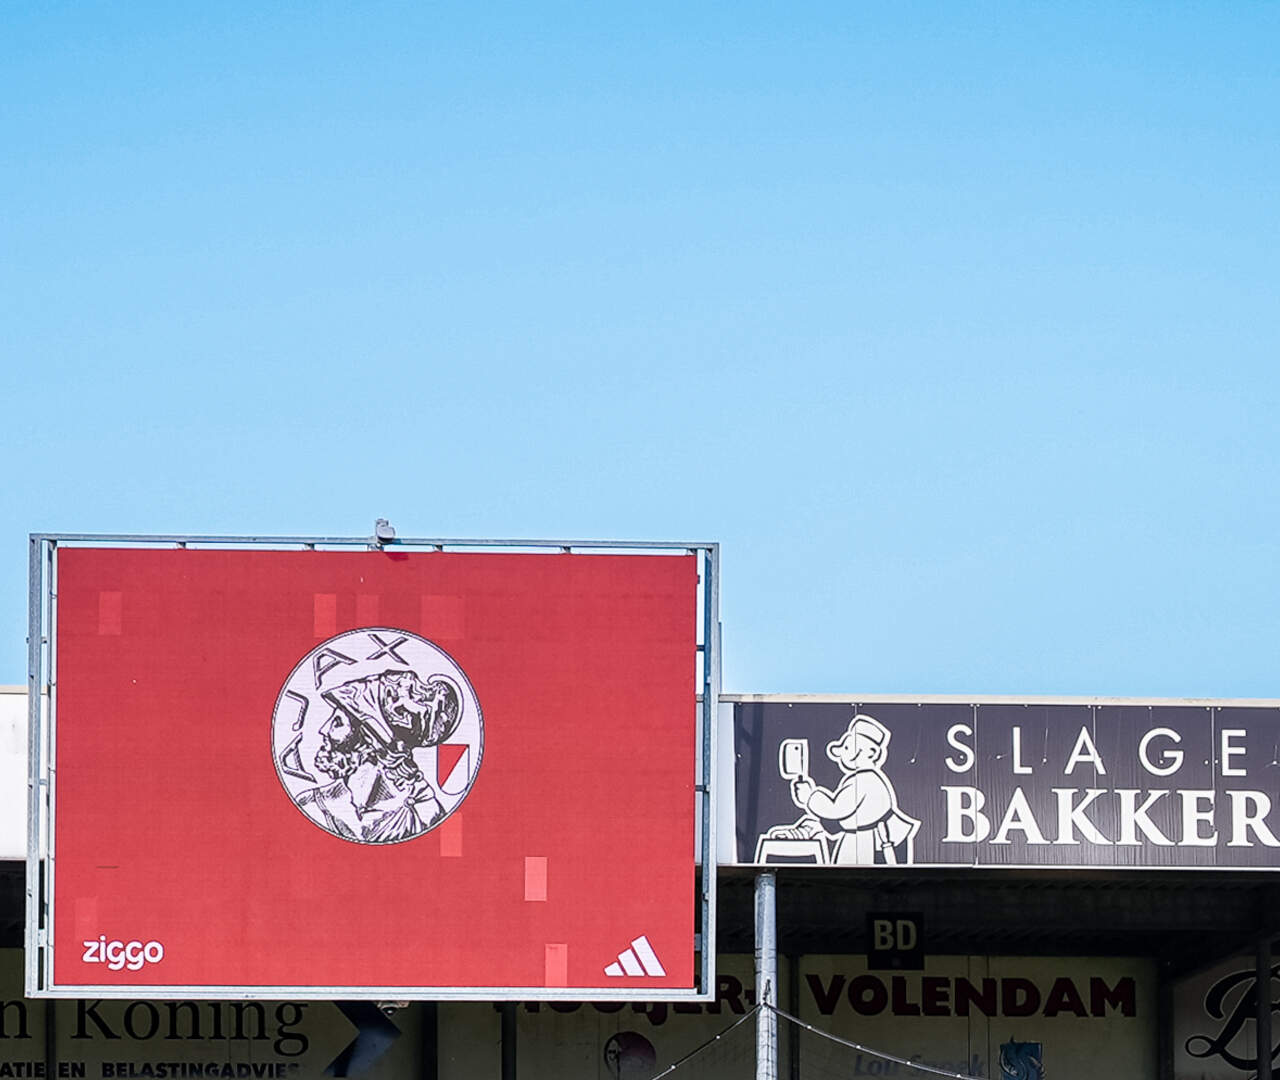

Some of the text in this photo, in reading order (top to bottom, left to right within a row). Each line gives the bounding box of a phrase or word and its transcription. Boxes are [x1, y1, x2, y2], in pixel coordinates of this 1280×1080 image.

[280, 632, 411, 783] AJAX
[82, 936, 165, 971] ziggo
[874, 920, 917, 950] BD
[806, 974, 1136, 1017] VOLENDAM
[71, 1000, 308, 1056] Koning
[59, 1062, 85, 1078] EN
